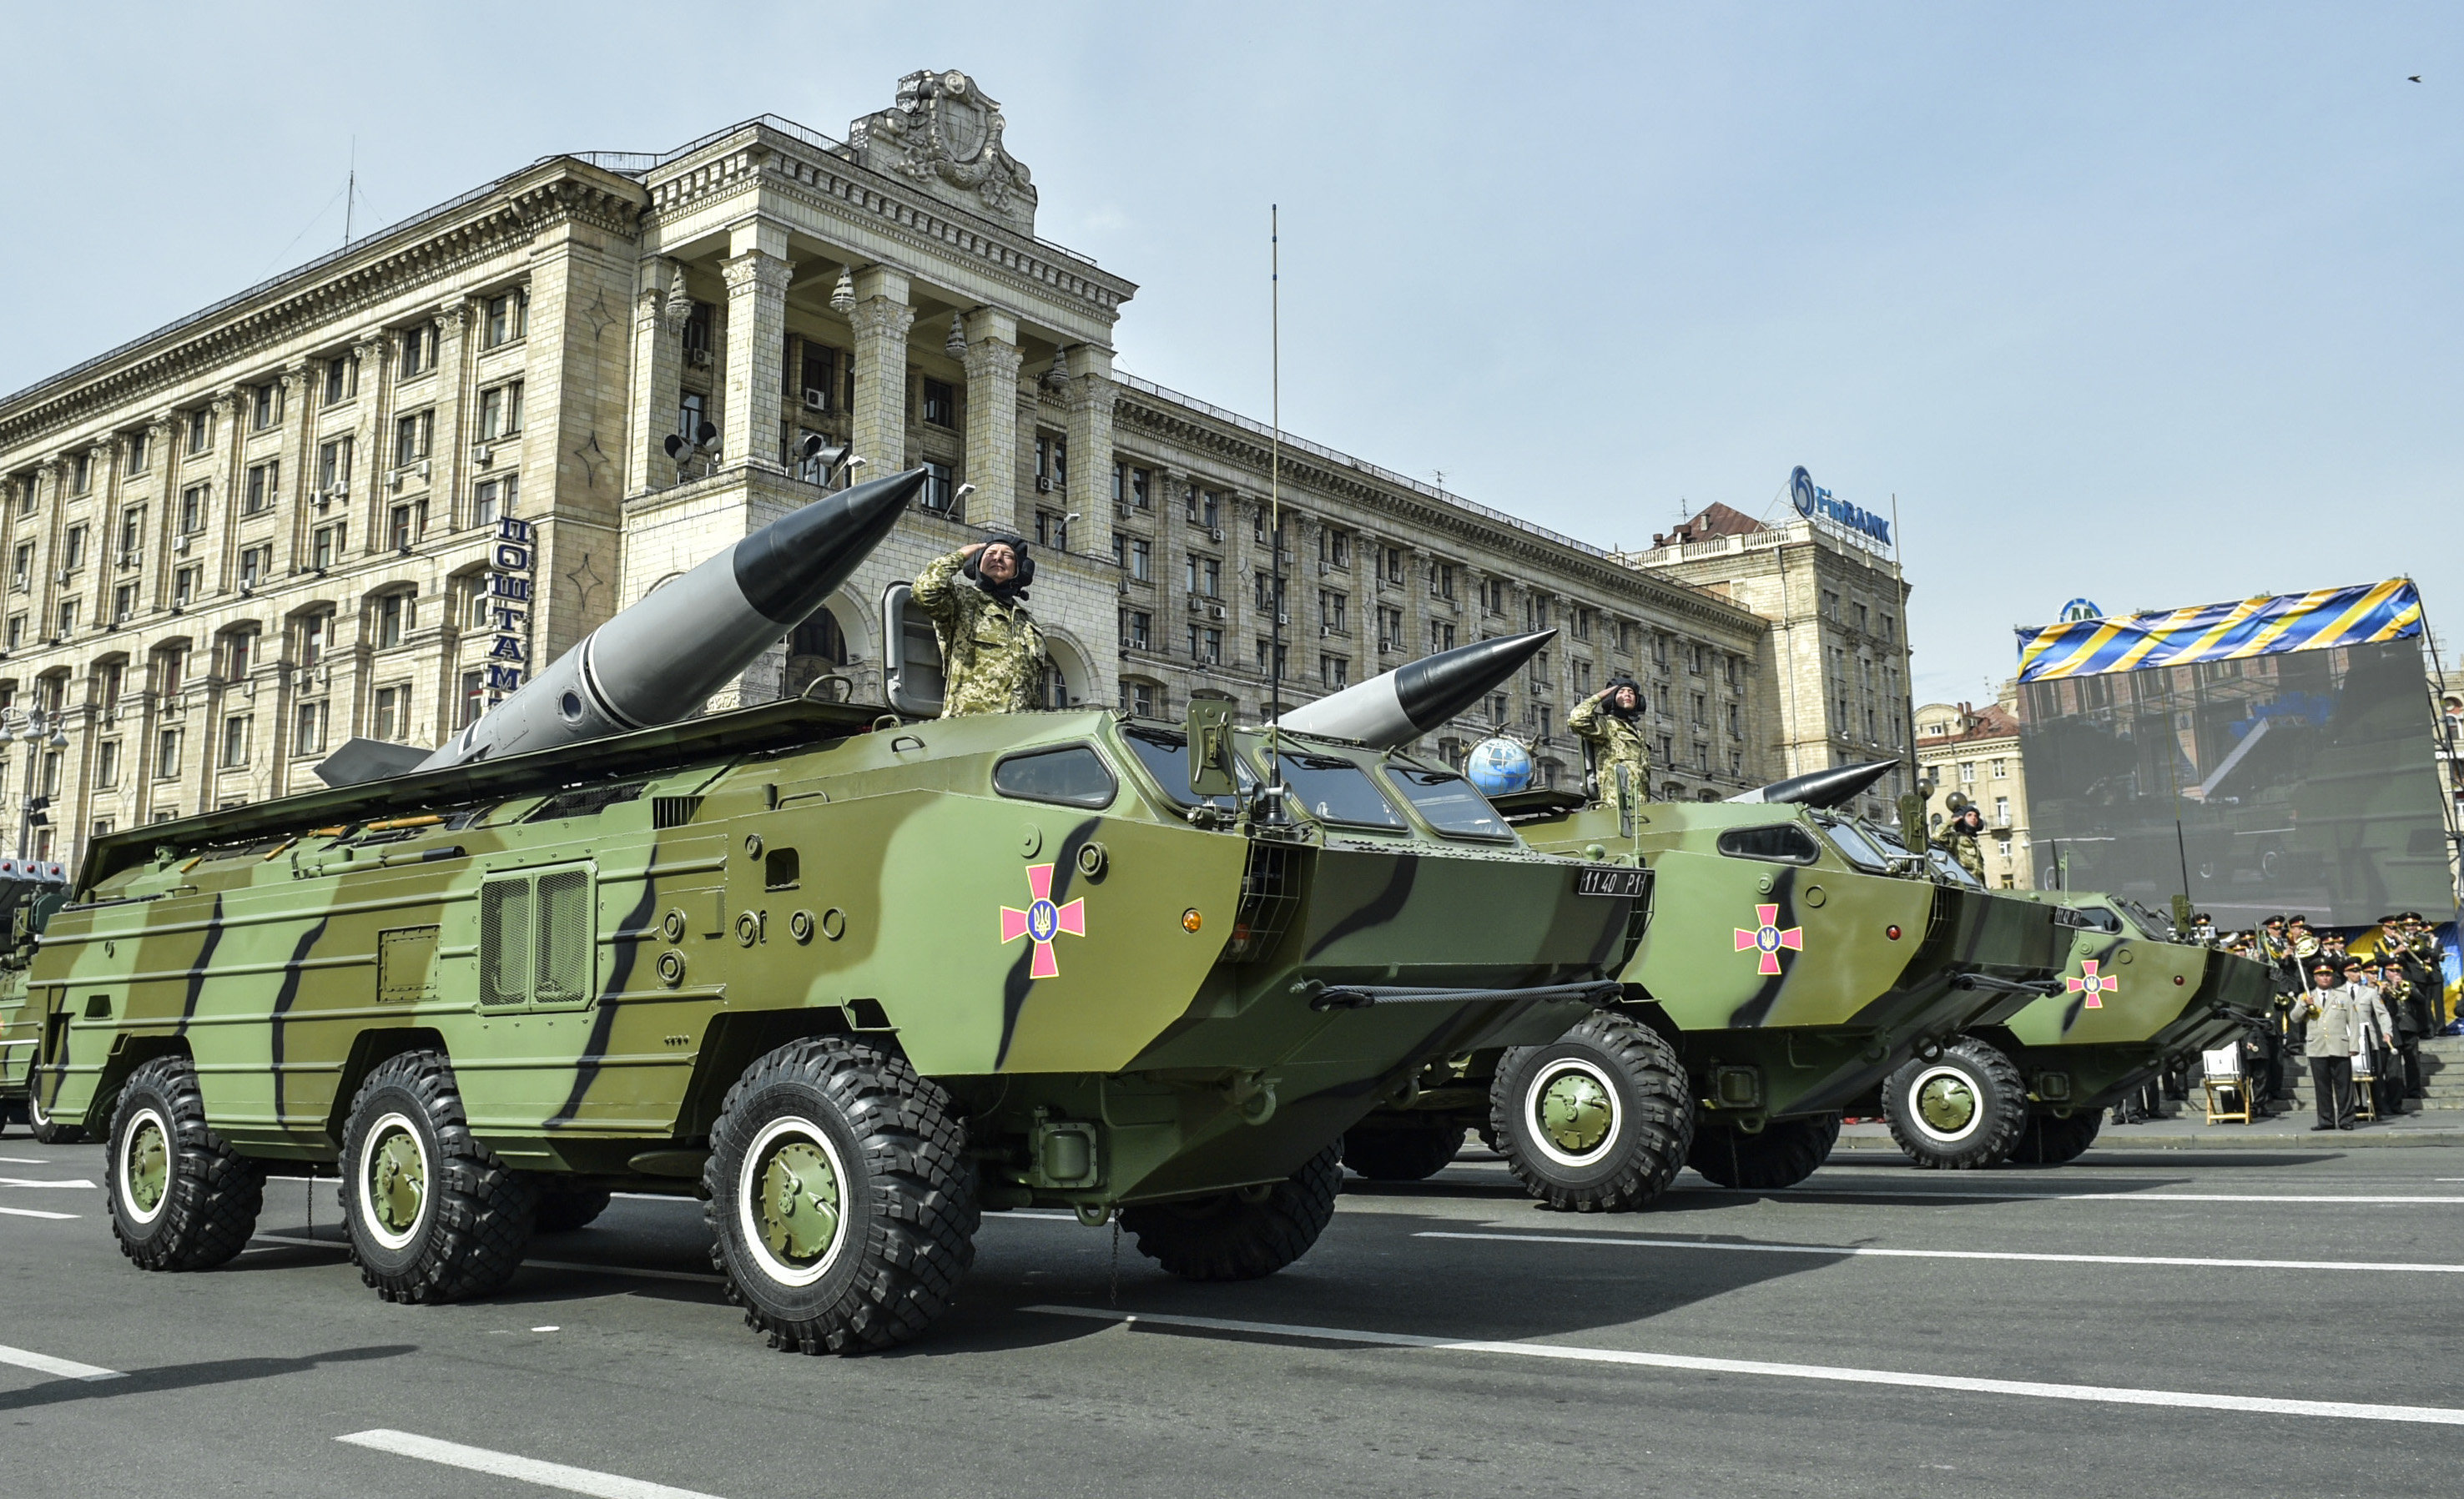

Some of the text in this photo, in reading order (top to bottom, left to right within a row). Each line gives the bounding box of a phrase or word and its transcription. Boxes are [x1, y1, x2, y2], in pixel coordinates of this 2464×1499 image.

[1816, 486, 1892, 546] FinBANK
[487, 516, 531, 711] ПОШТАМ
[1585, 871, 1618, 893] 1140
